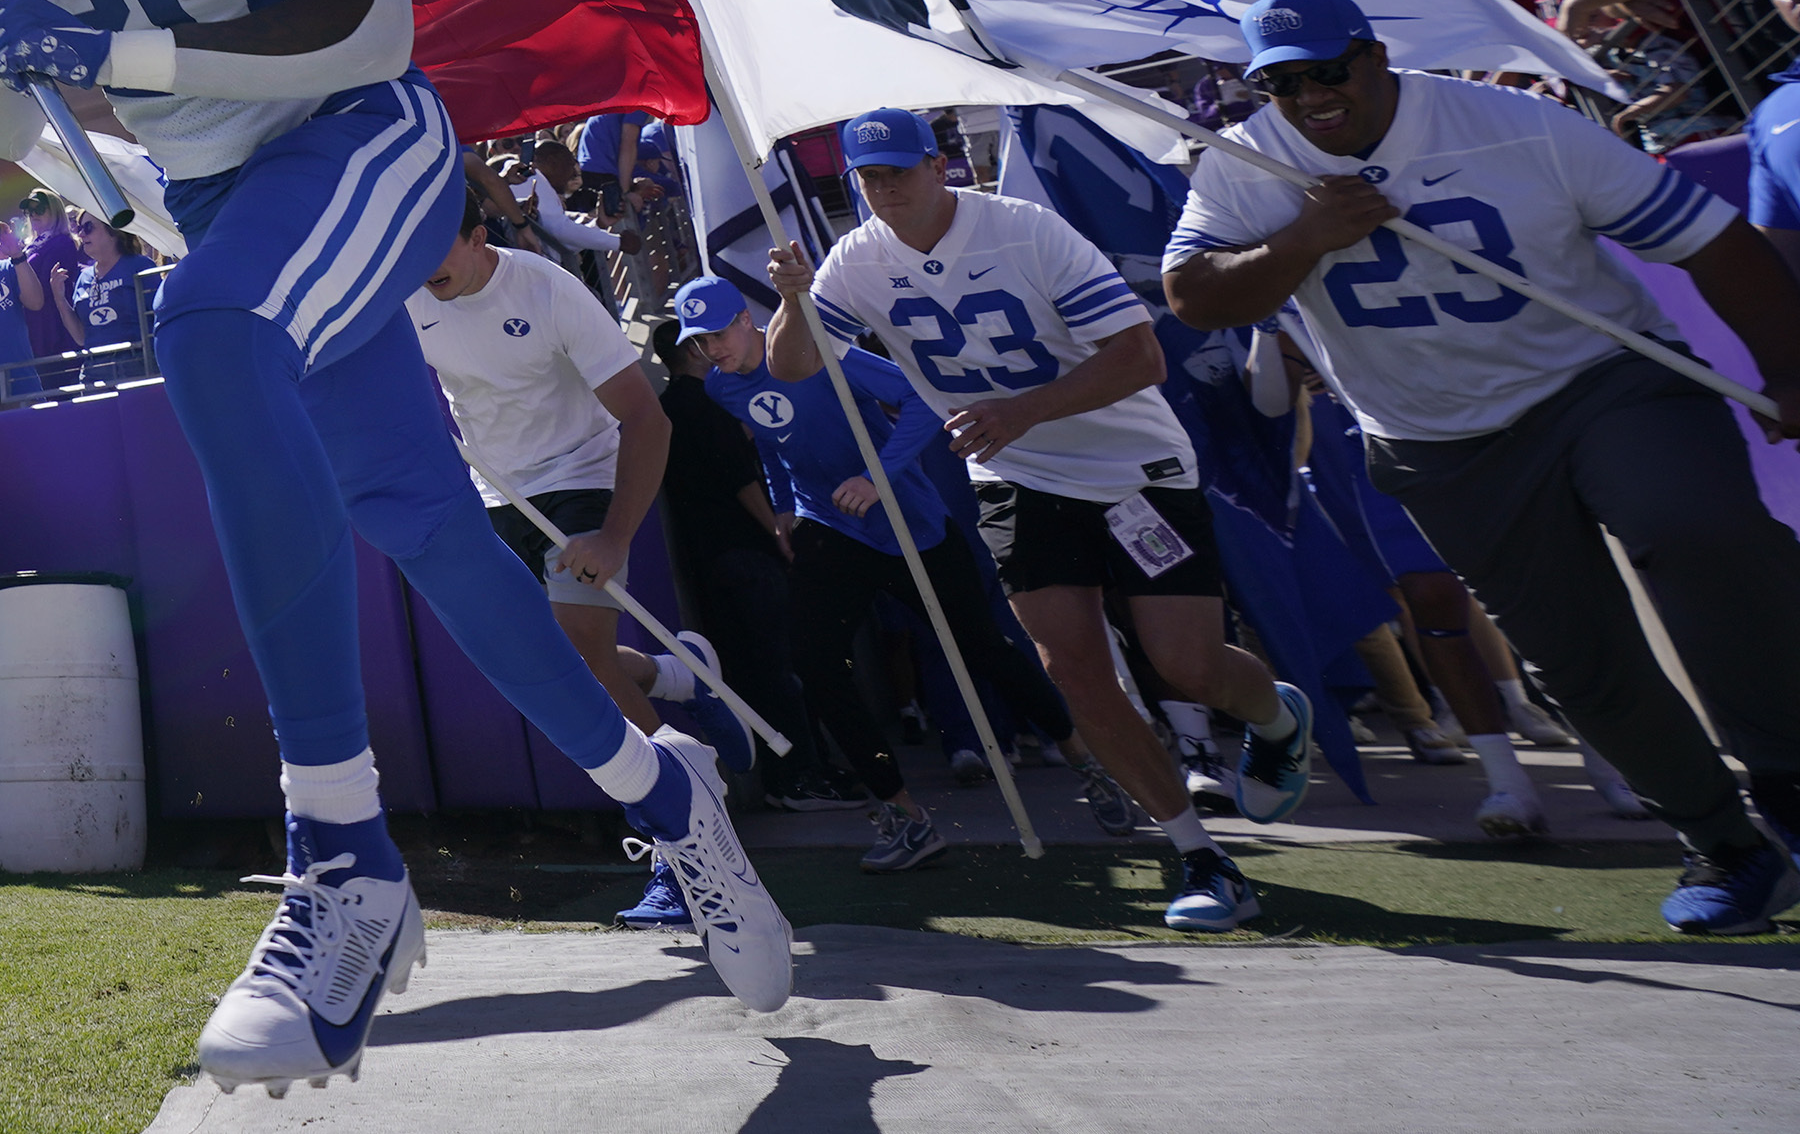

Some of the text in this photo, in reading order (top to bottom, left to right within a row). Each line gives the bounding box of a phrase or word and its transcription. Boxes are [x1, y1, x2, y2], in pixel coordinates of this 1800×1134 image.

[1260, 16, 1302, 36] BYU
[857, 127, 891, 144] BYU
[1323, 196, 1533, 328] 23
[889, 289, 1060, 394] 23
